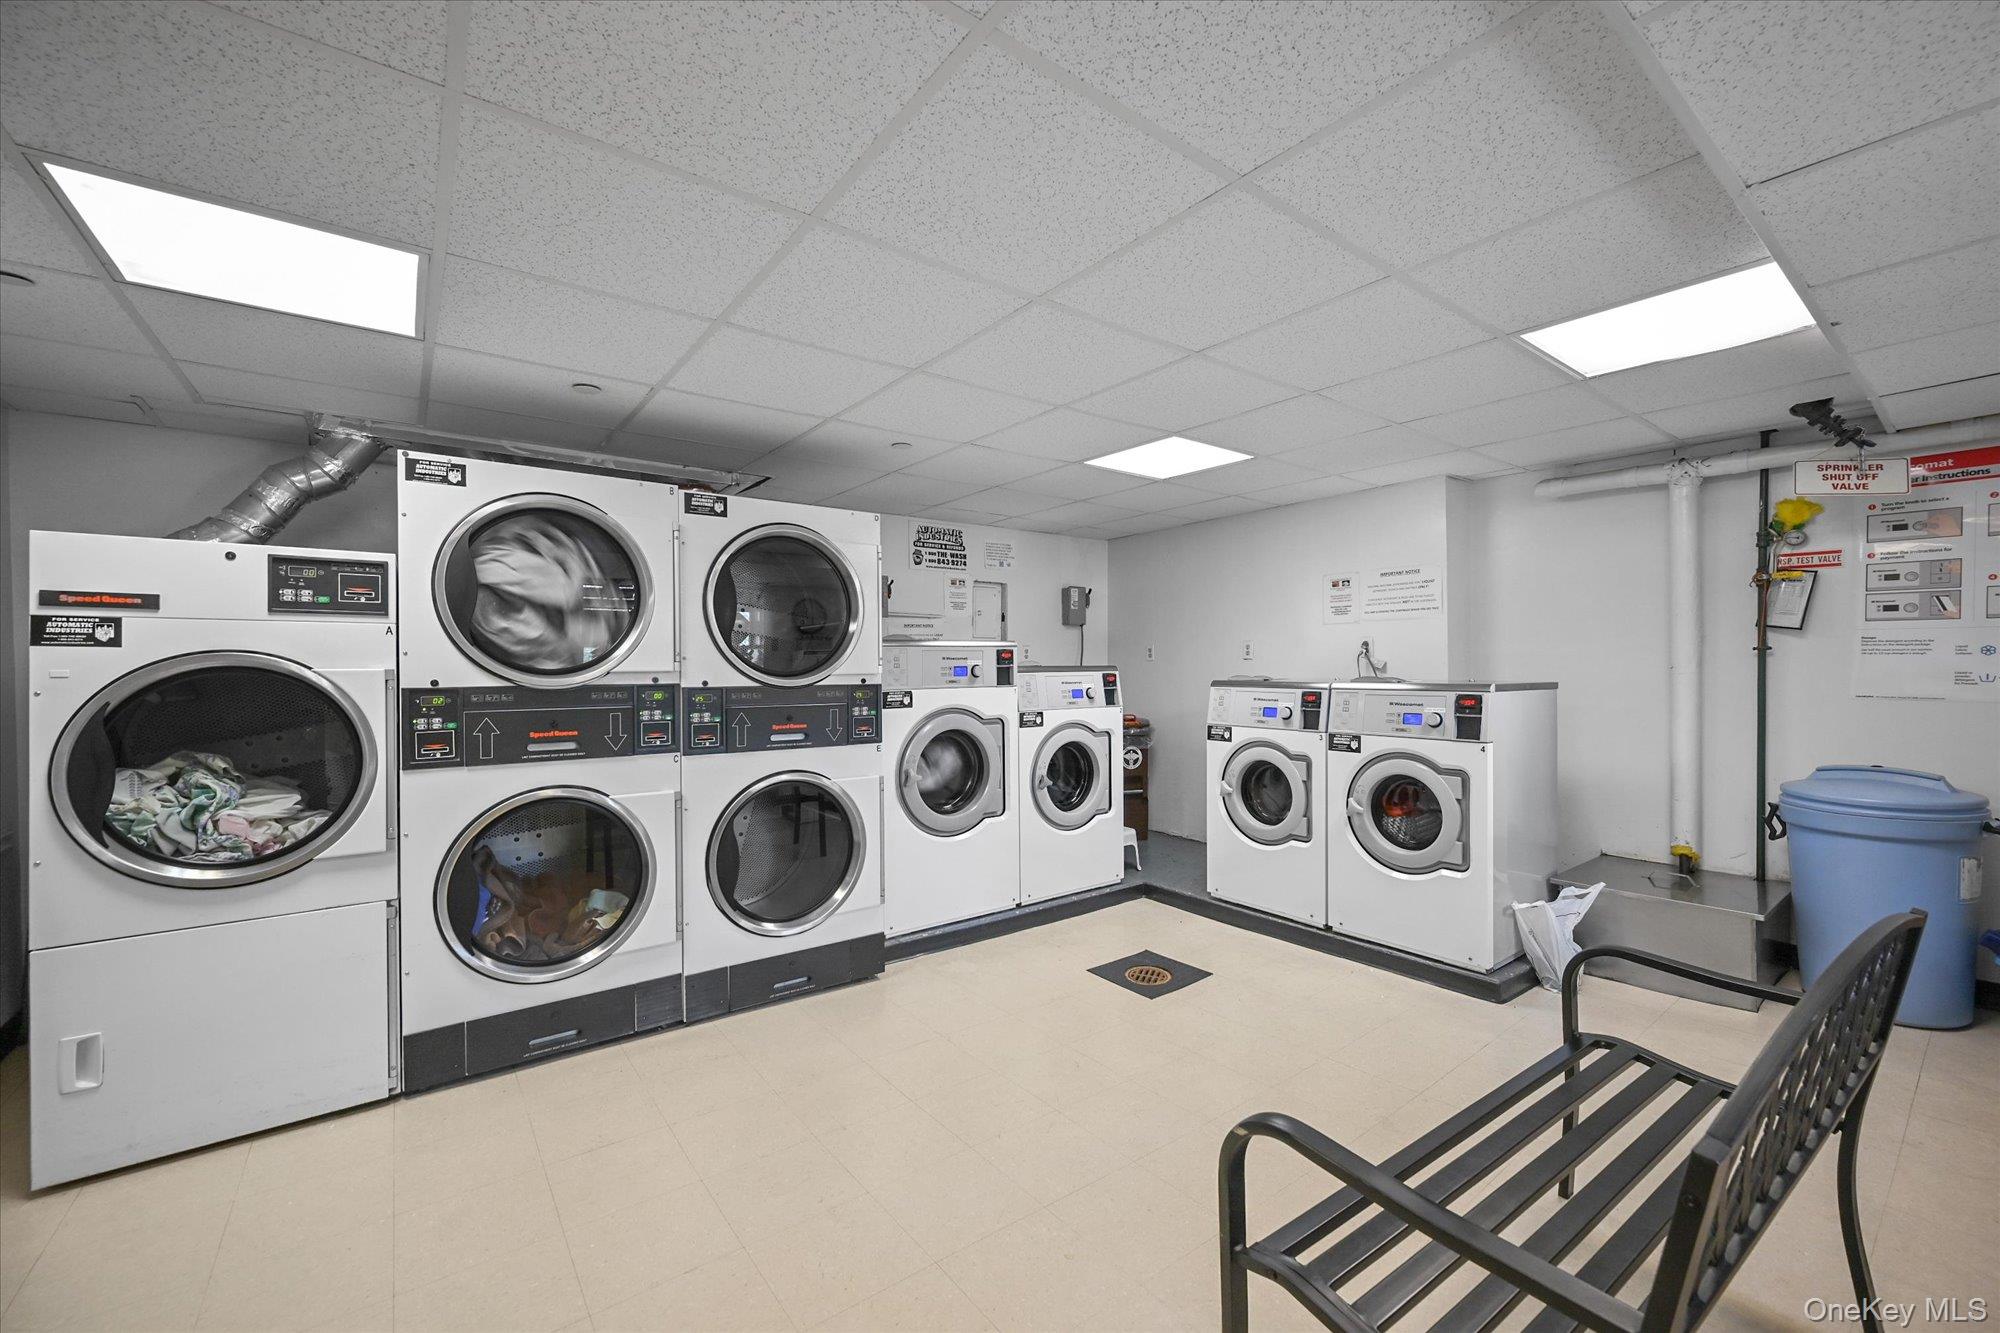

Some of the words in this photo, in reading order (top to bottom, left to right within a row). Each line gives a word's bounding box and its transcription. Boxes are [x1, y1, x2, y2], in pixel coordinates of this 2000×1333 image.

[1817, 463, 1884, 472] SPRINKER
[1822, 473, 1852, 481] SHUT
[1922, 468, 1991, 482] Instructions
[1832, 482, 1870, 491] VALVE
[1796, 556, 1814, 564] TEST
[1817, 554, 1842, 563] VALVE
[59, 594, 101, 603] Speed
[102, 595, 142, 604] Queen
[386, 626, 393, 635] A
[529, 731, 554, 739] Speed
